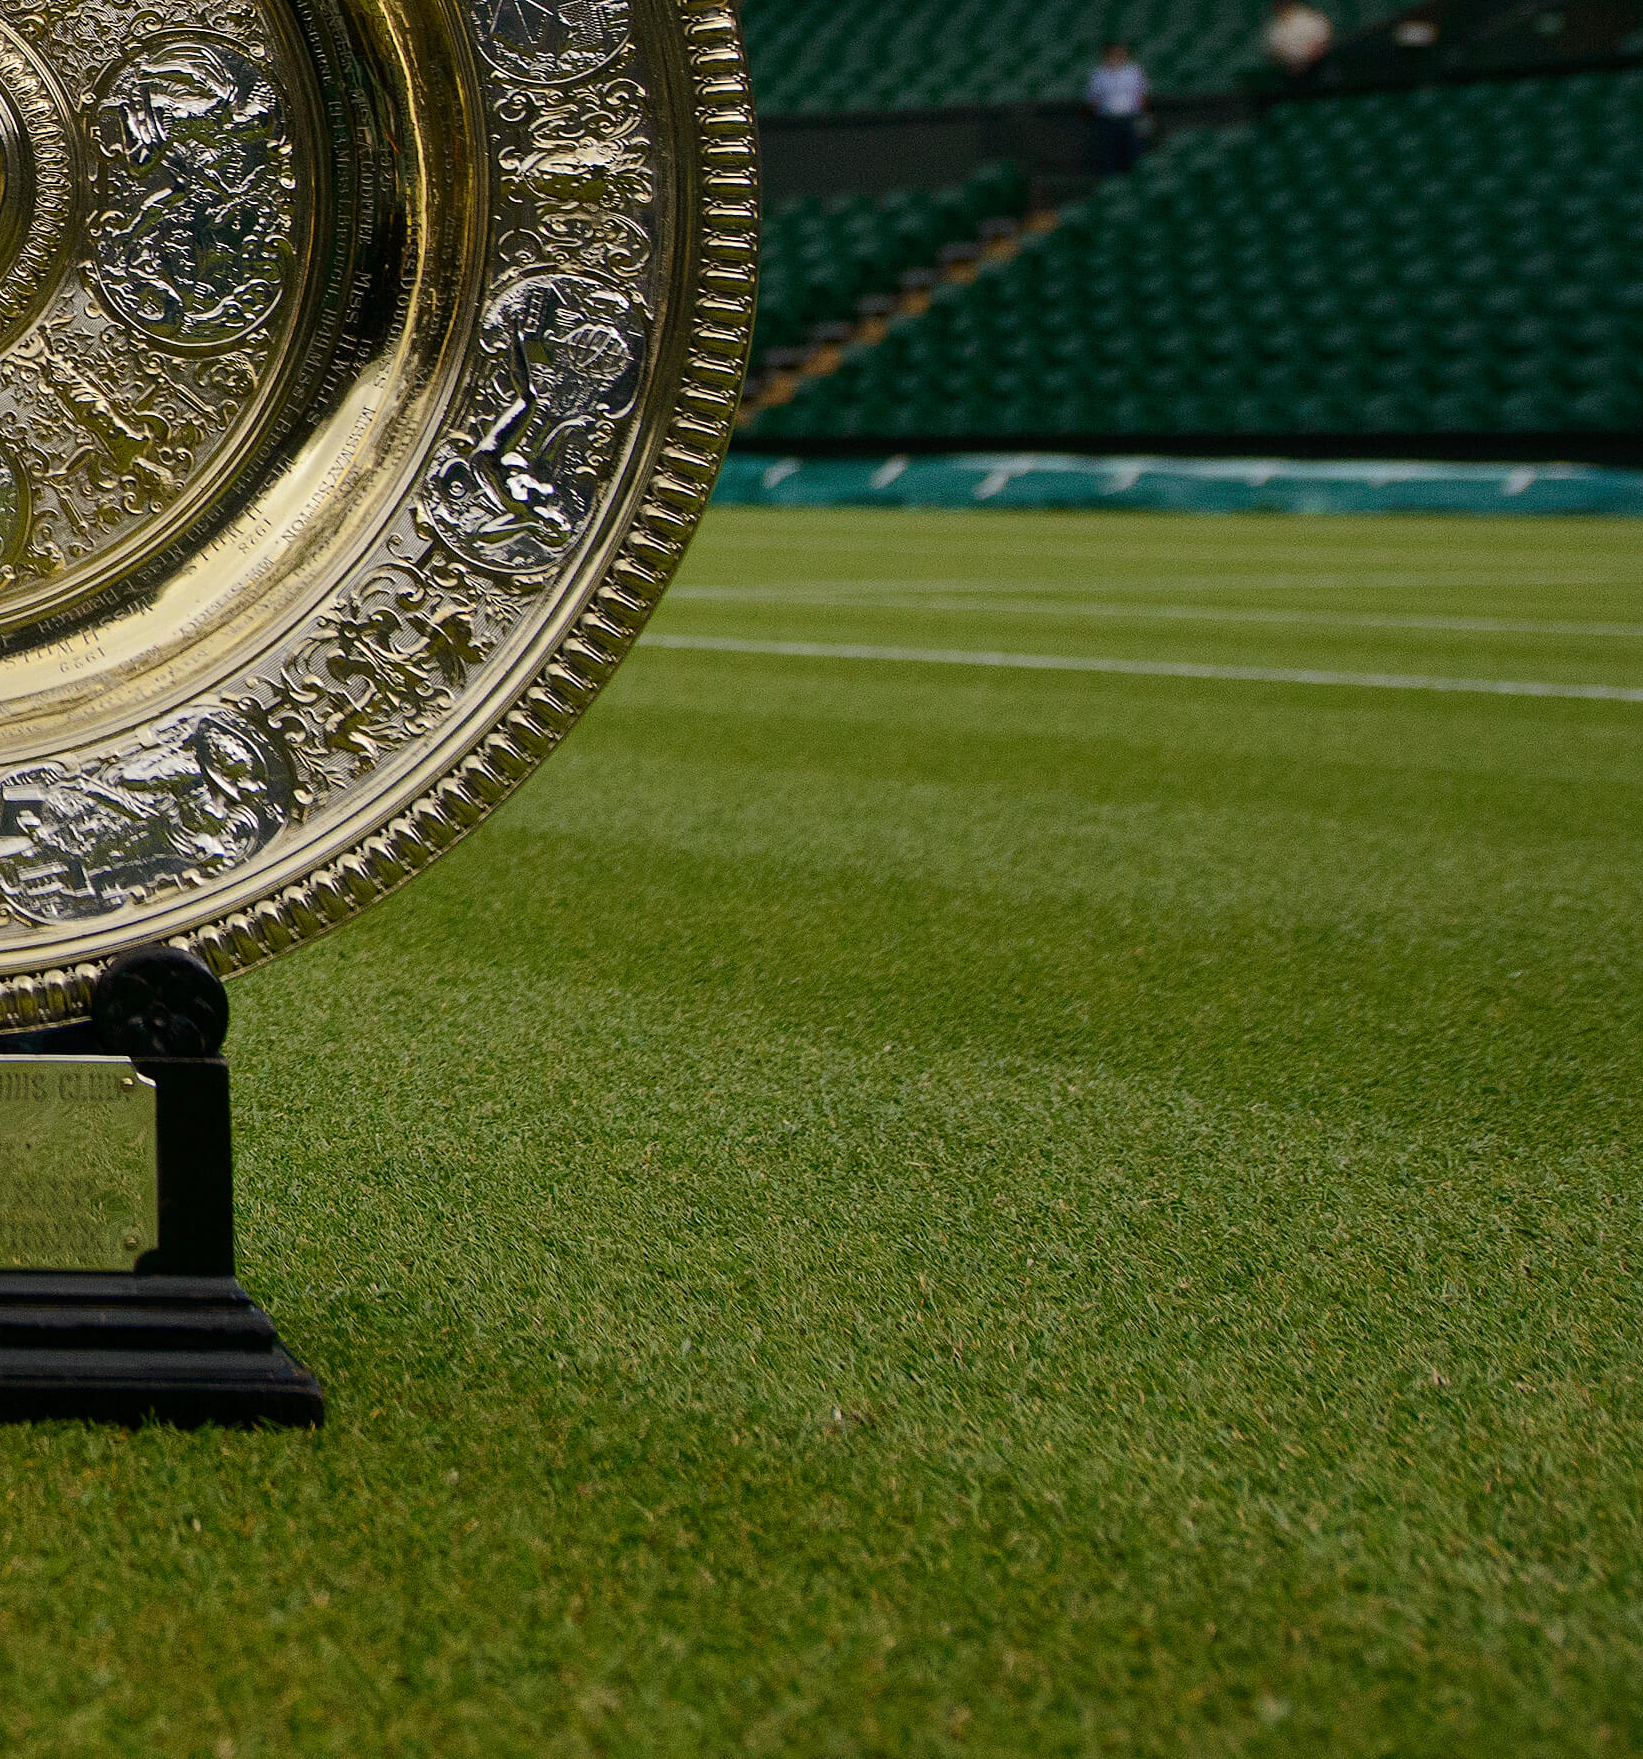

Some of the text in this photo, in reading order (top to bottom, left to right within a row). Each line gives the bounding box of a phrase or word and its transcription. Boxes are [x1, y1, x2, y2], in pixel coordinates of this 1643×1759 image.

[343, 270, 373, 326] MISS
[343, 403, 377, 451] MISS
[325, 445, 355, 483] MAY
[235, 515, 275, 557] 1928
